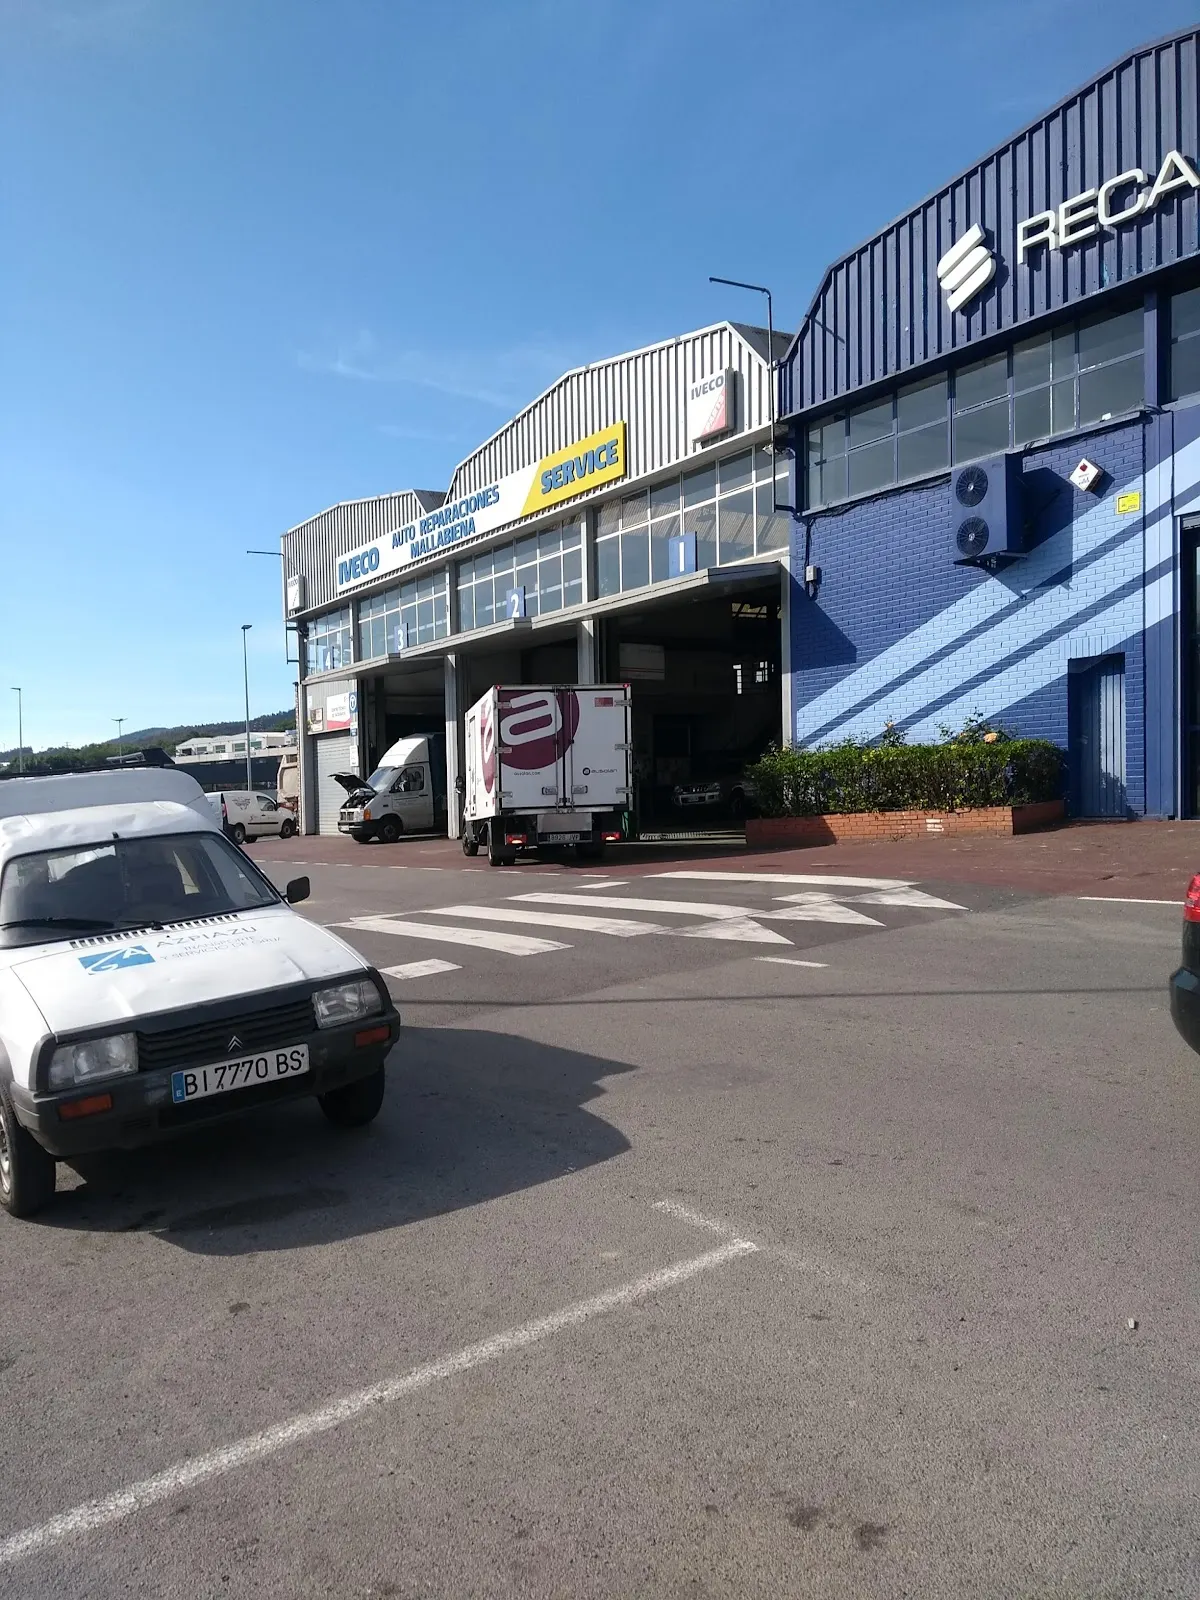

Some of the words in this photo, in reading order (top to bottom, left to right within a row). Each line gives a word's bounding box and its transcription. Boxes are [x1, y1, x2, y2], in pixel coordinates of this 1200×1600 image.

[691, 375, 724, 400] IVECO
[541, 439, 619, 495] SERVICE
[392, 524, 416, 549] AUTO
[420, 485, 500, 536] REPARACIONES
[410, 517, 476, 559] MALLABIENA
[338, 547, 380, 585] IVECO
[679, 542, 686, 573] 1
[511, 593, 520, 614] 2
[397, 629, 404, 650] 3
[325, 652, 331, 671] 4
[156, 926, 257, 948] AZPIAZU
[172, 945, 229, 960] SERVICIO
[214, 1057, 269, 1090] 7770
[276, 1050, 302, 1075] BS
